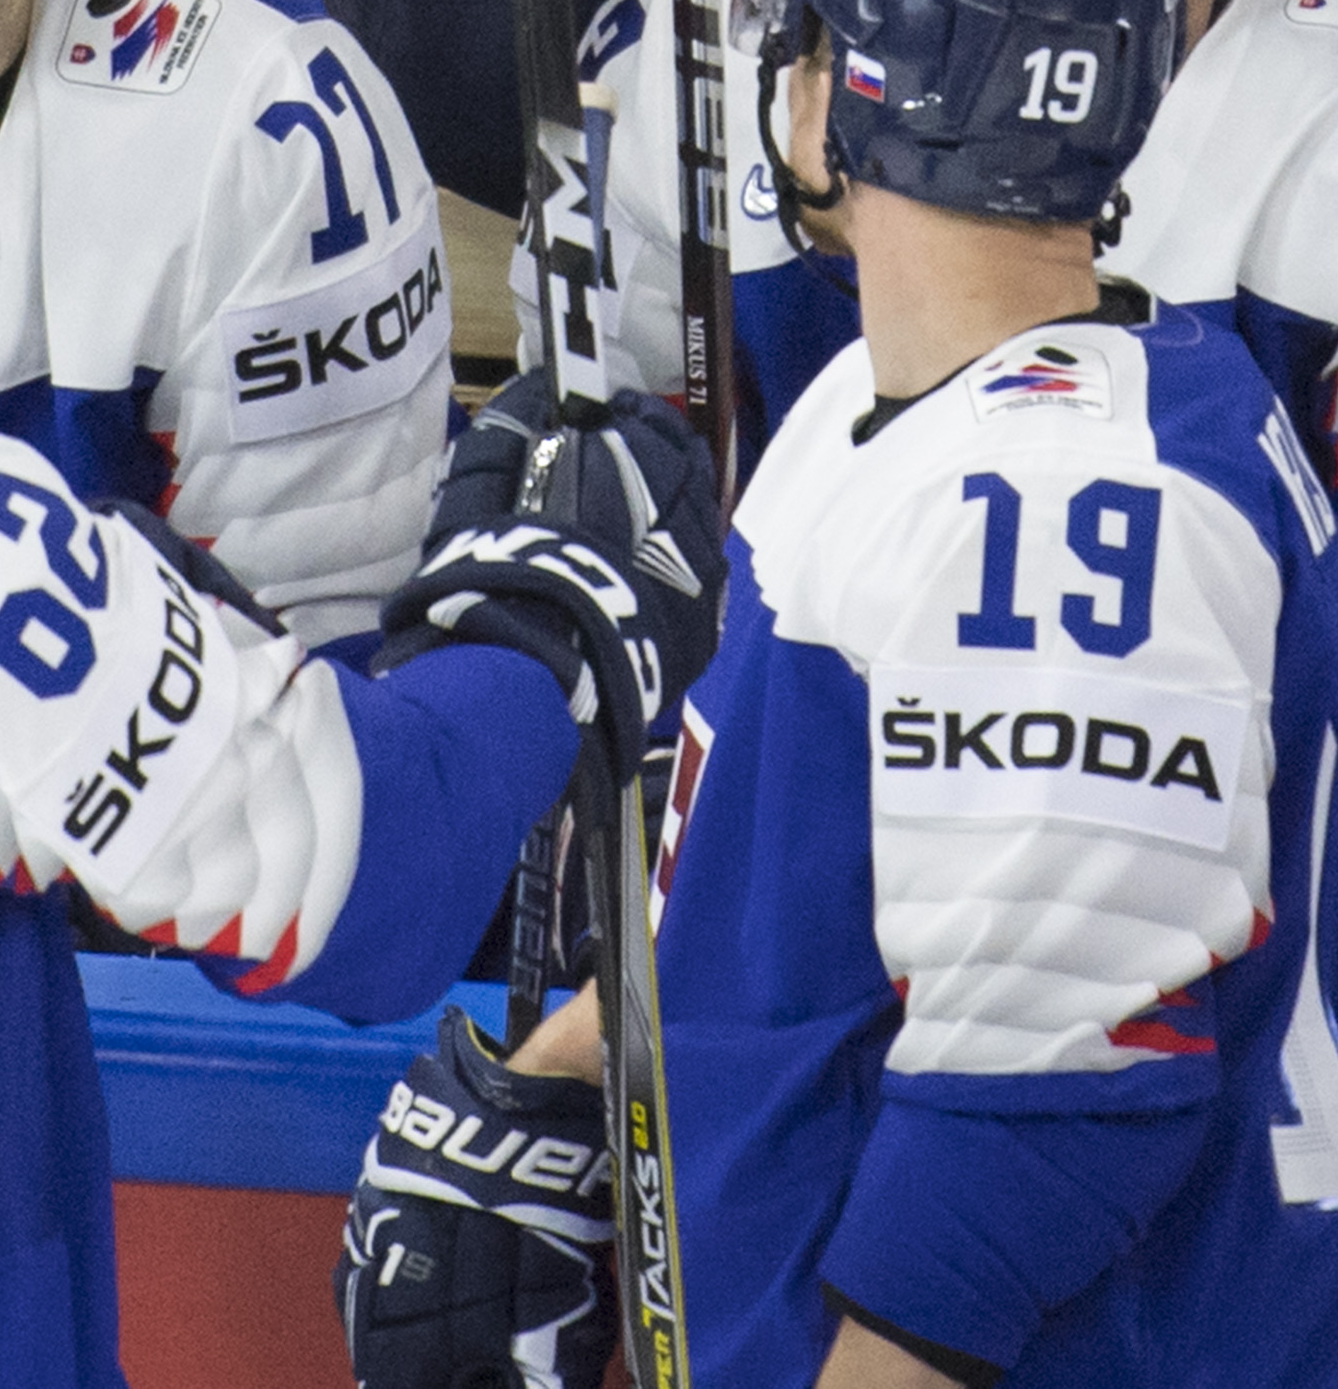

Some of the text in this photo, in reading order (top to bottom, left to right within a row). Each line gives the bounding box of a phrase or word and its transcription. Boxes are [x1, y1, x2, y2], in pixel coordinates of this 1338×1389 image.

[255, 47, 401, 265] 17
[1020, 47, 1099, 124] 19
[234, 249, 443, 405] ŠKODA
[688, 314, 707, 381] MIKUS
[956, 472, 1163, 660] 19
[63, 566, 206, 856] ŠKODA
[881, 697, 1224, 804] ŠKODA
[632, 1151, 676, 1322] TACKS
